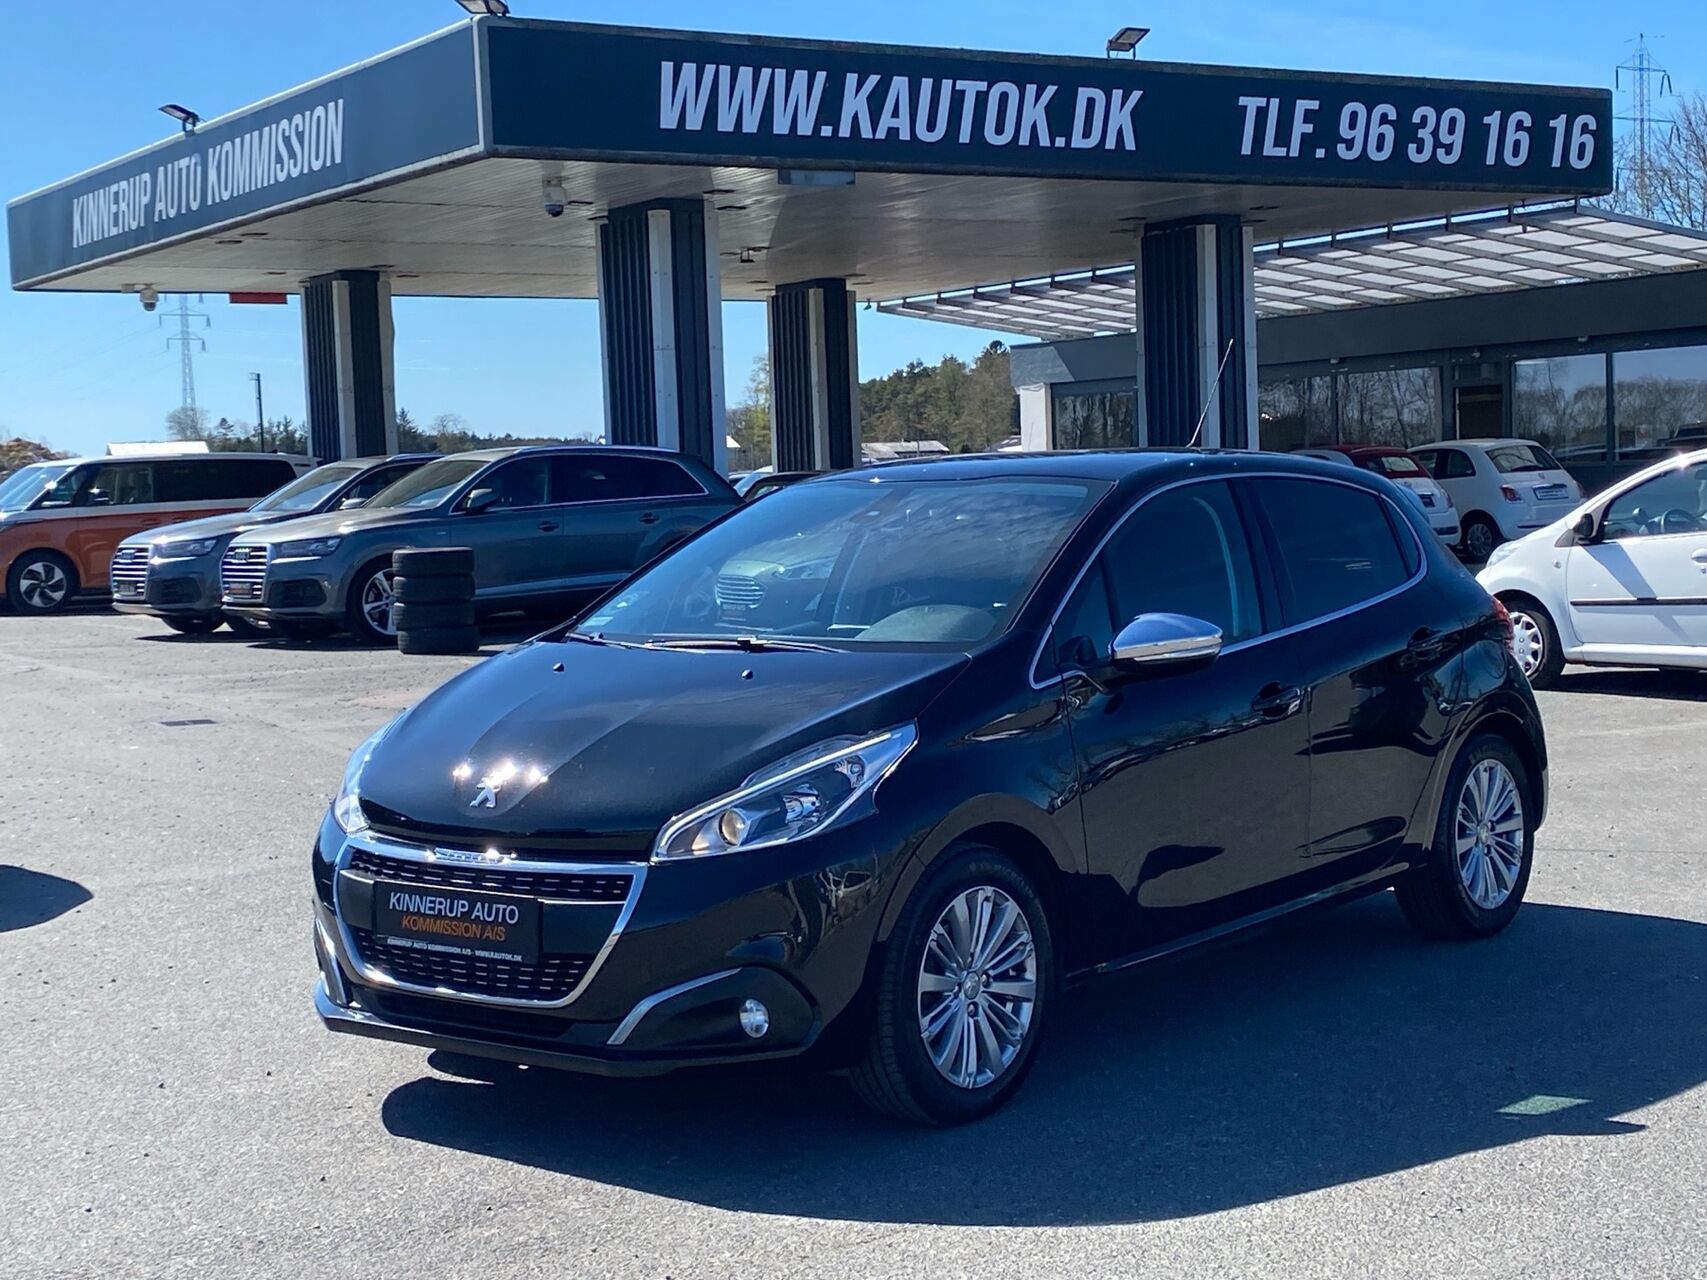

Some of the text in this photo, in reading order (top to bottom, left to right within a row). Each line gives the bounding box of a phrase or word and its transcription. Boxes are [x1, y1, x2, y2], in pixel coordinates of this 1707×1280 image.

[659, 60, 1144, 151] WWW.KAUTOK.DK
[1238, 96, 1598, 170] TLF. 96 39 16 16
[72, 99, 344, 249] KINNERUP AUTO KOMMISSION
[389, 892, 519, 924] KINNERUP AUTO
[402, 915, 482, 939] KOMMISSION
